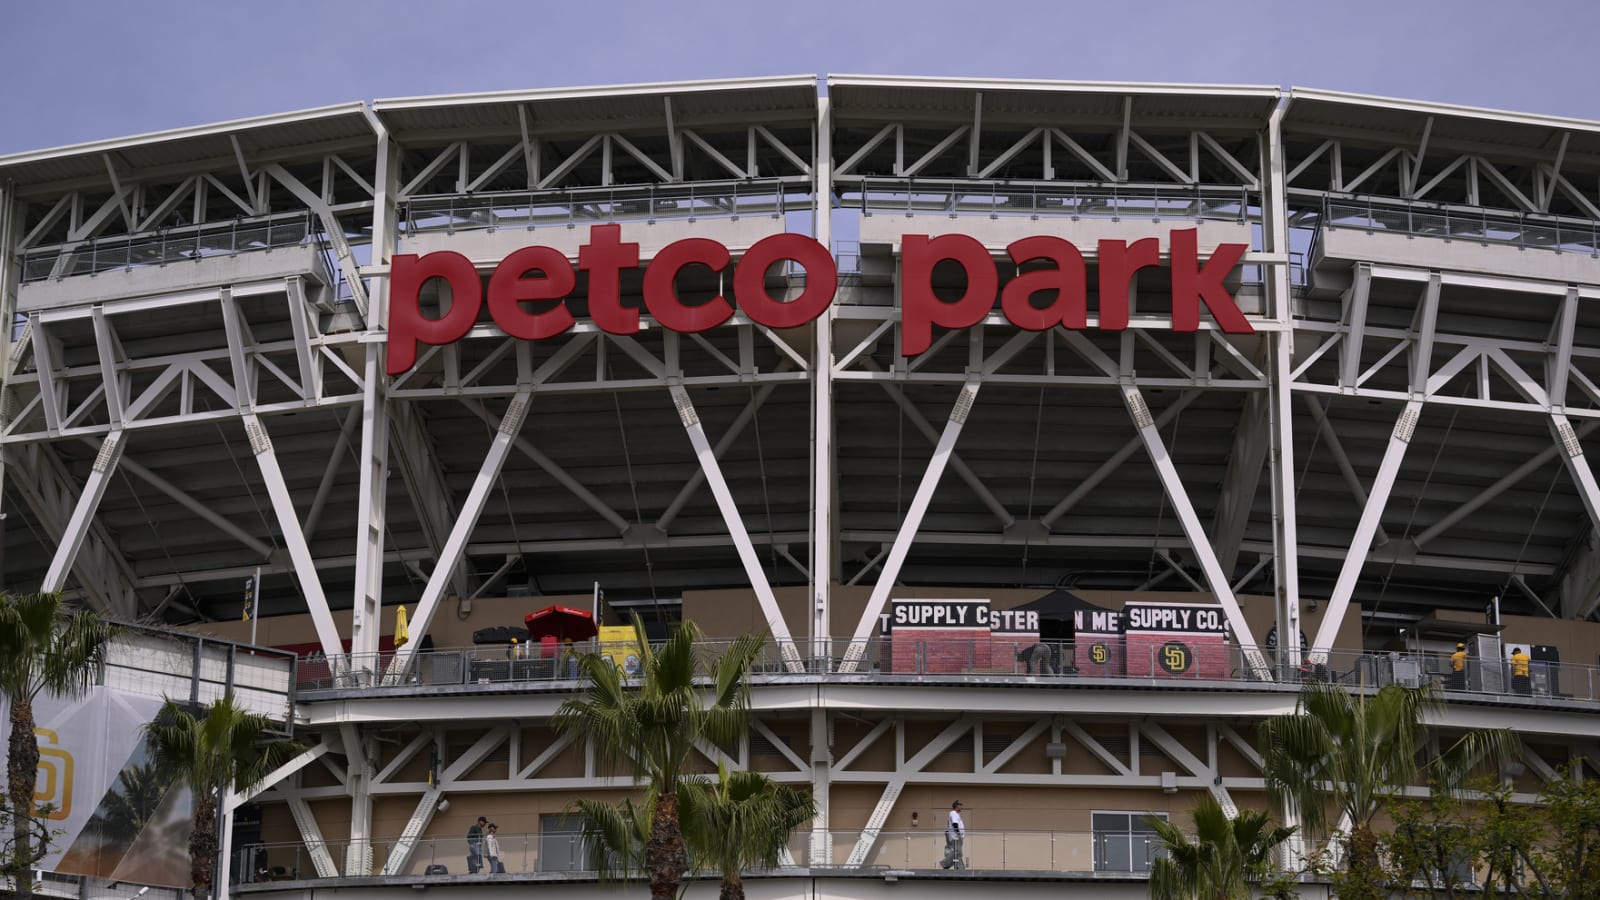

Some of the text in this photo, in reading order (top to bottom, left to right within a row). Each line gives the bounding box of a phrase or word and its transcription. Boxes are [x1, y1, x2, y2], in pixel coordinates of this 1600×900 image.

[386, 224, 1255, 376] petco park
[895, 605, 968, 624] SUPPLY
[1130, 608, 1191, 629] SUPPLY
[1196, 610, 1223, 630] CO.
